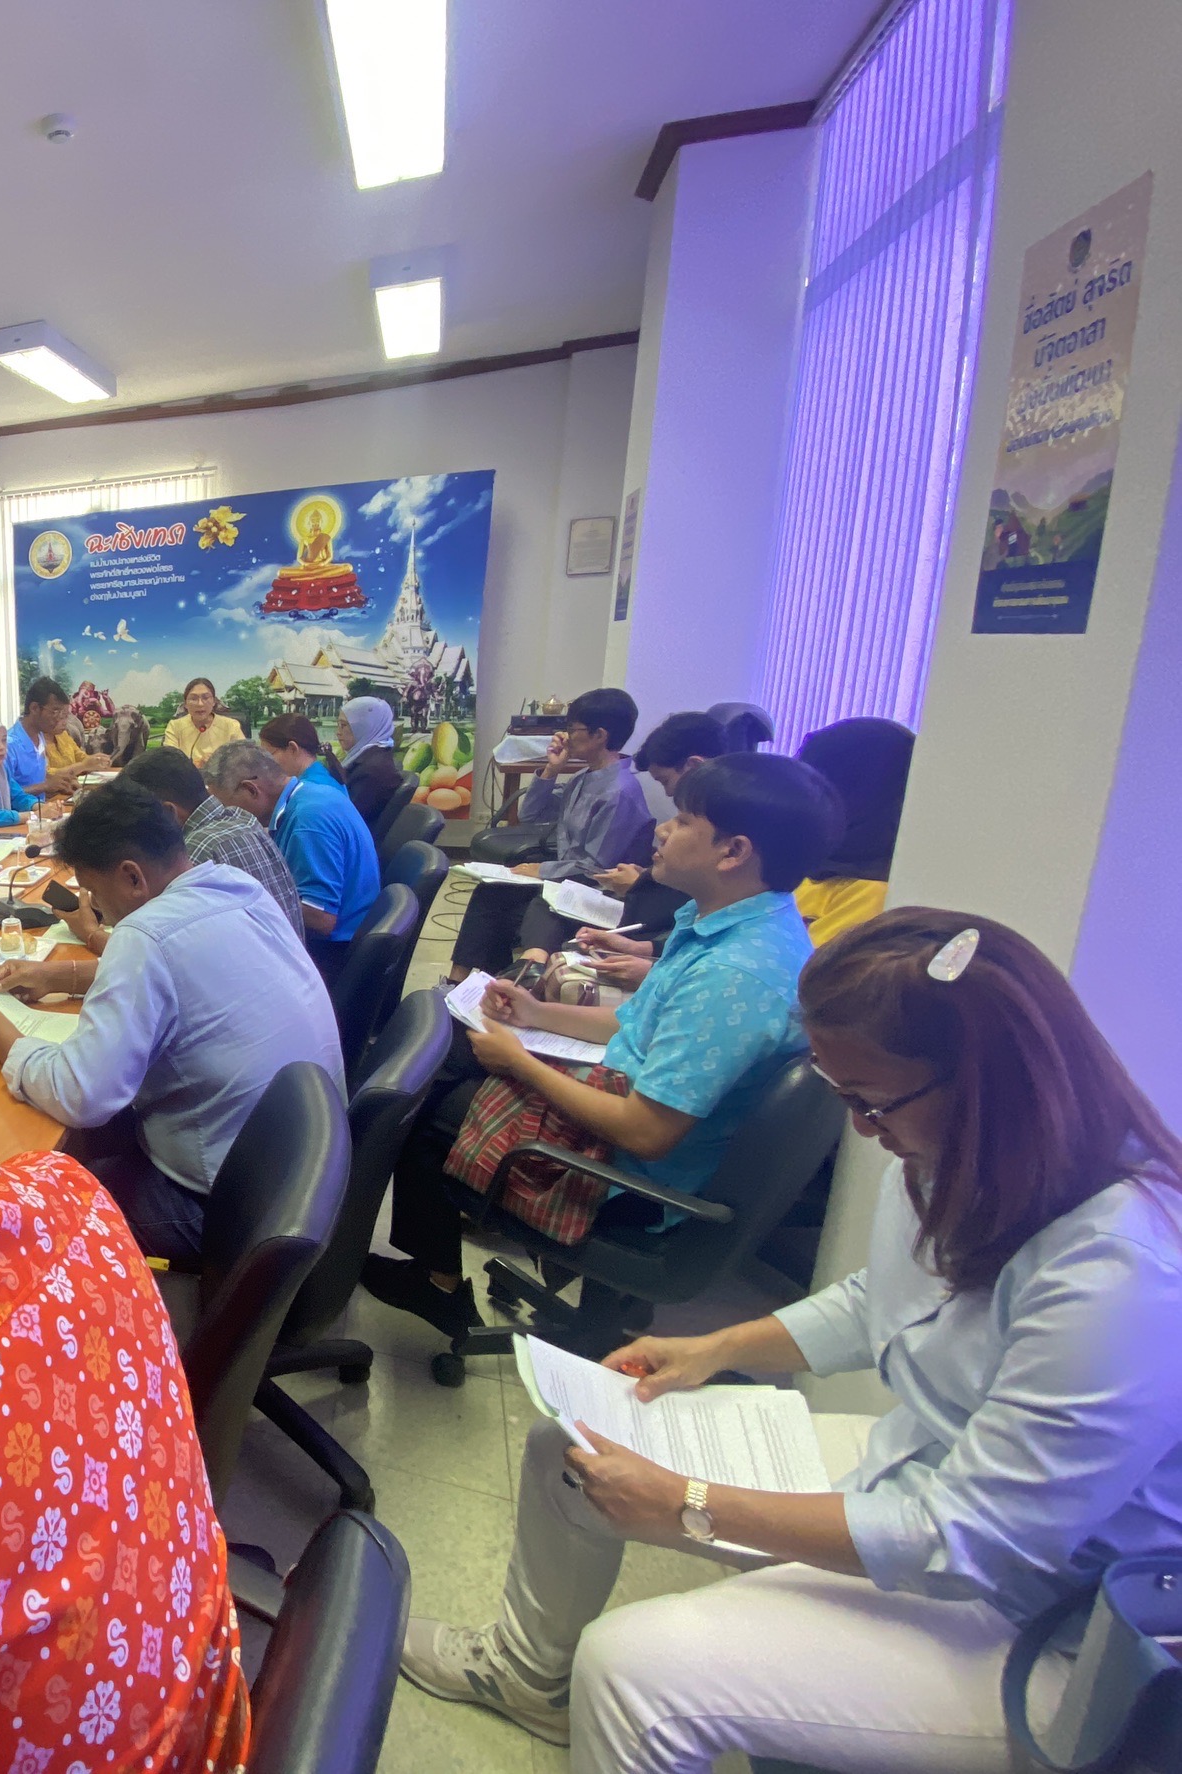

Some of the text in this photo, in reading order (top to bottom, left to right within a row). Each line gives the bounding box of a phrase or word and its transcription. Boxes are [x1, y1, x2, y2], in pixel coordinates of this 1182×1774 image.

[1083, 258, 1133, 311] สุจริต
[85, 522, 186, 554] ฉะเชิงเทรา
